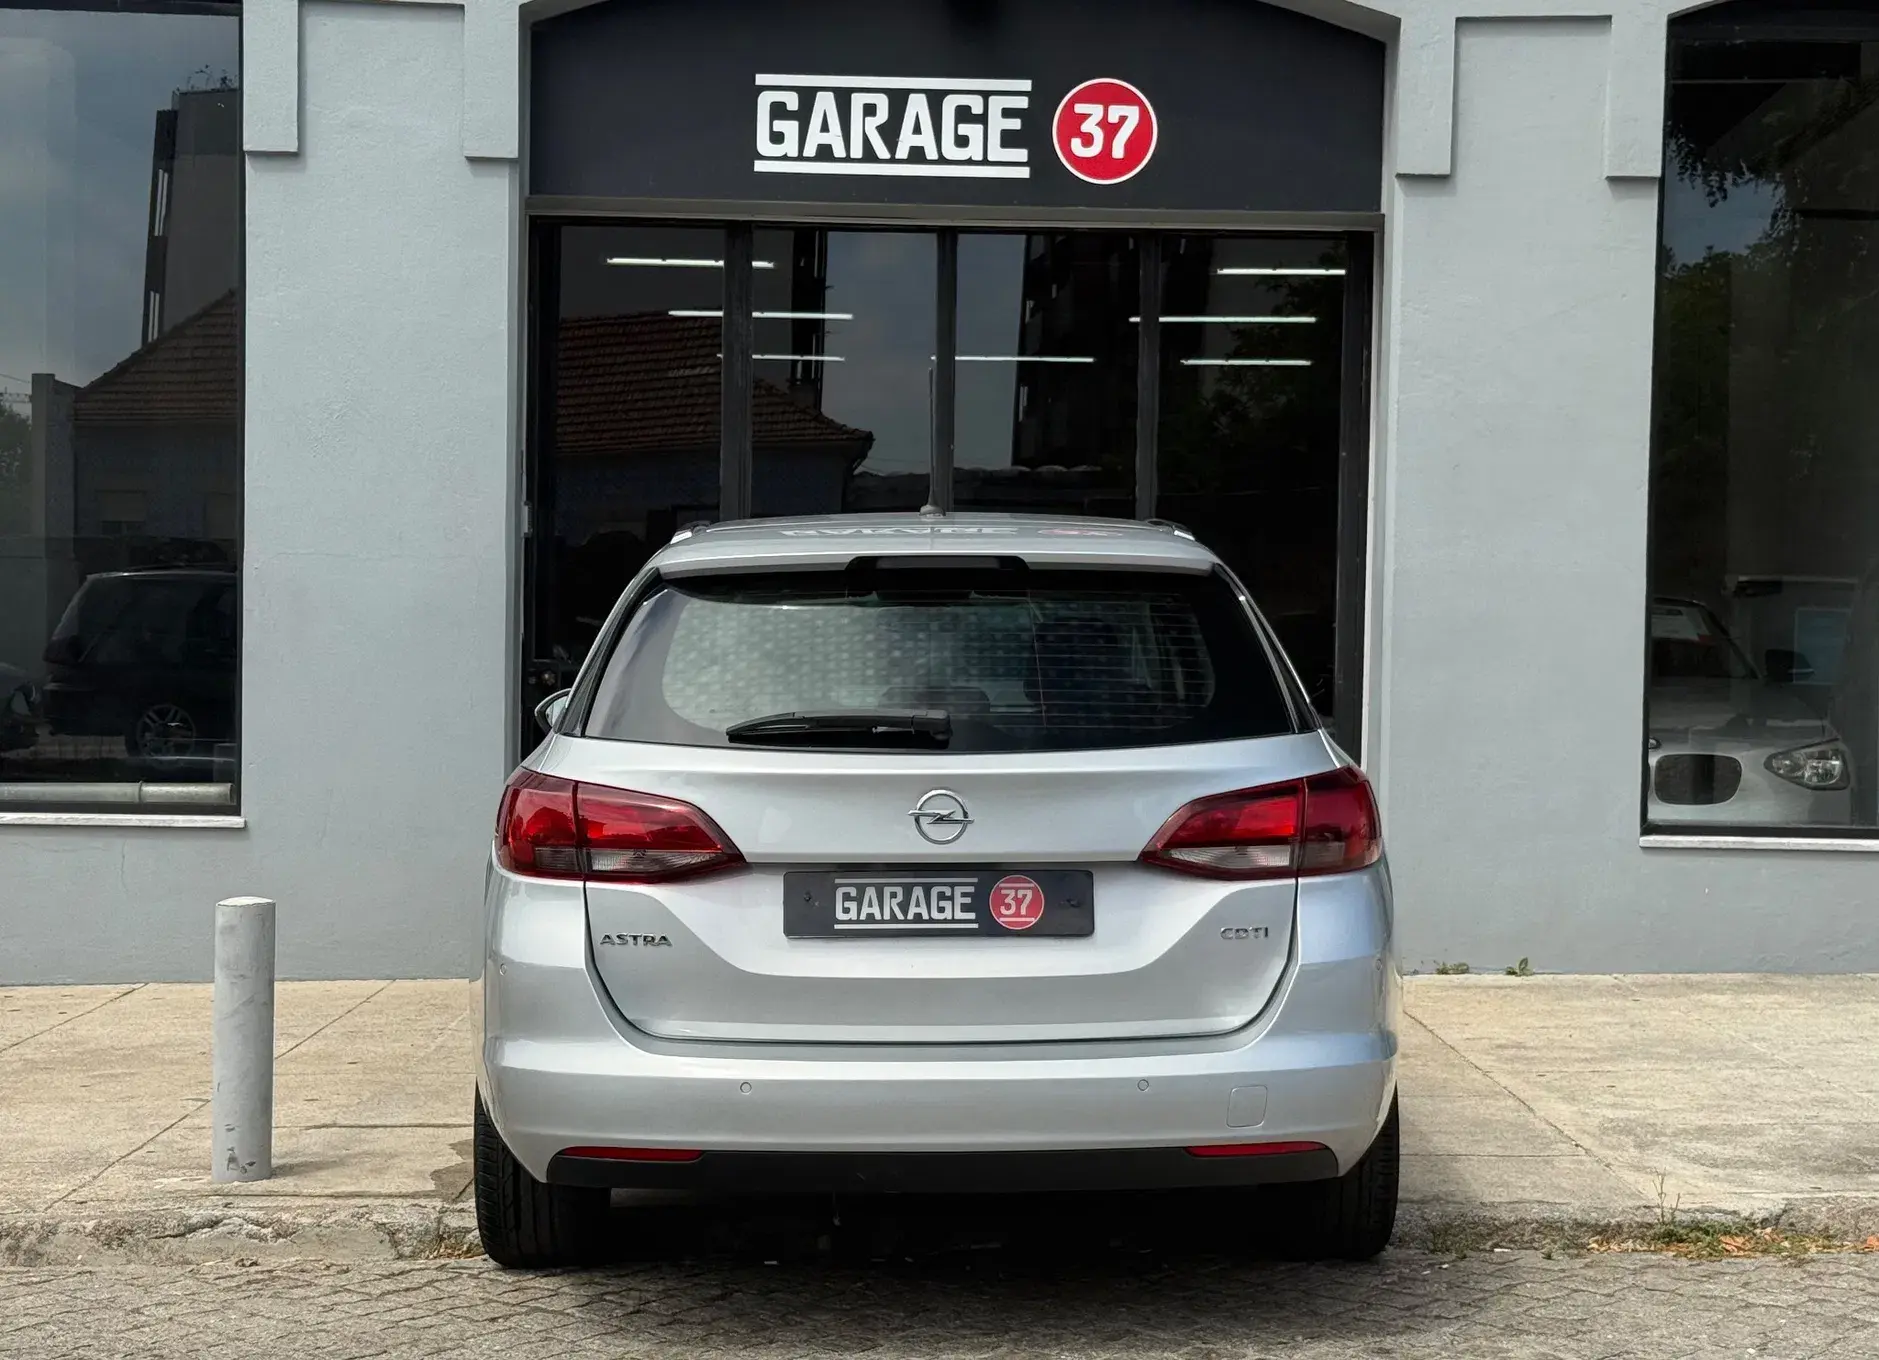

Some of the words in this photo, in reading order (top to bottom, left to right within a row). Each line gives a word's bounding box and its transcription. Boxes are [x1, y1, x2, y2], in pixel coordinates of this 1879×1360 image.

[756, 91, 1029, 163] GARAGE
[1070, 103, 1140, 160] 37
[835, 886, 976, 921] GARAGE
[999, 889, 1034, 917] 37
[600, 932, 674, 947] ASTRA
